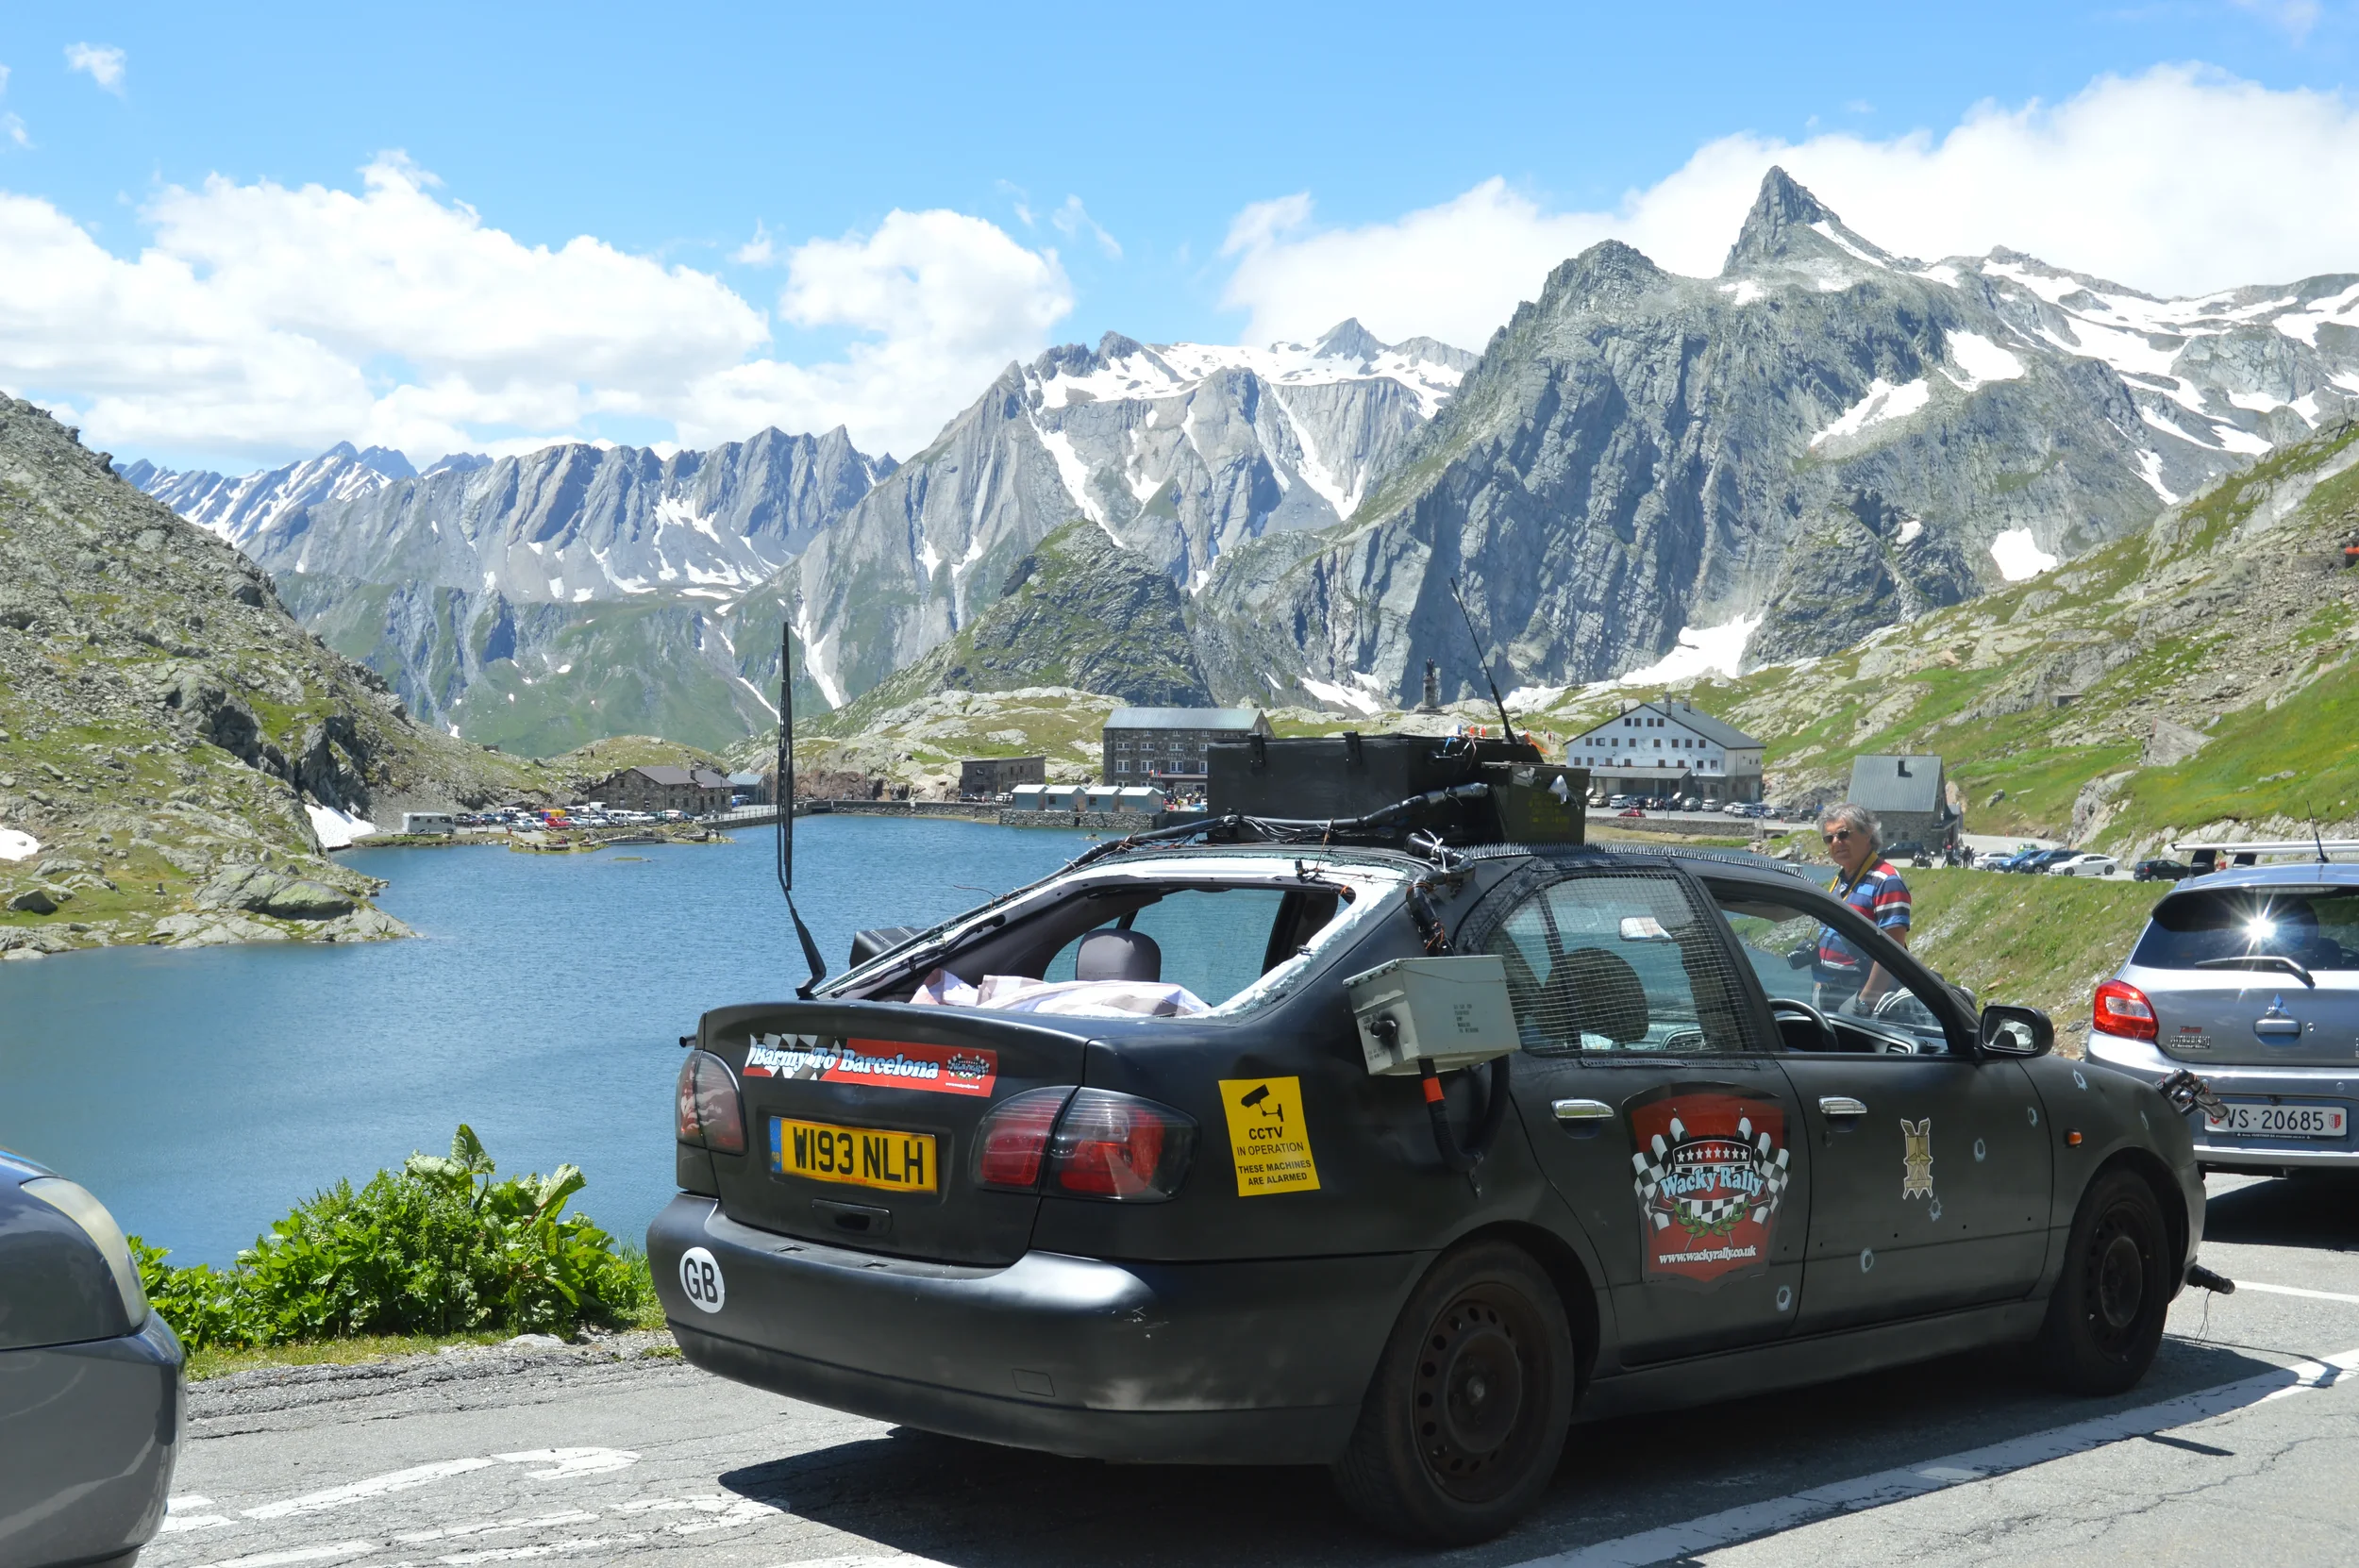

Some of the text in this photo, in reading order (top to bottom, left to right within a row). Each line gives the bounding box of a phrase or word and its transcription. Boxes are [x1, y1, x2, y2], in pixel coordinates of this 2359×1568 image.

[753, 1043, 940, 1079] Barmy To Barcelona
[2228, 1109, 2324, 1131] VS 20685
[1248, 1126, 1283, 1140] CCTV
[793, 1126, 924, 1185] W193 NLH
[1236, 1142, 1304, 1157] IN OPERATION
[1238, 1159, 1312, 1175] THESE MACHINES
[1248, 1172, 1308, 1186] ARE ALARMED
[1660, 1166, 1764, 1198] Wacky Rally
[1659, 1244, 1757, 1264] www.wackyrally.co.uk
[684, 1257, 718, 1304] GB
